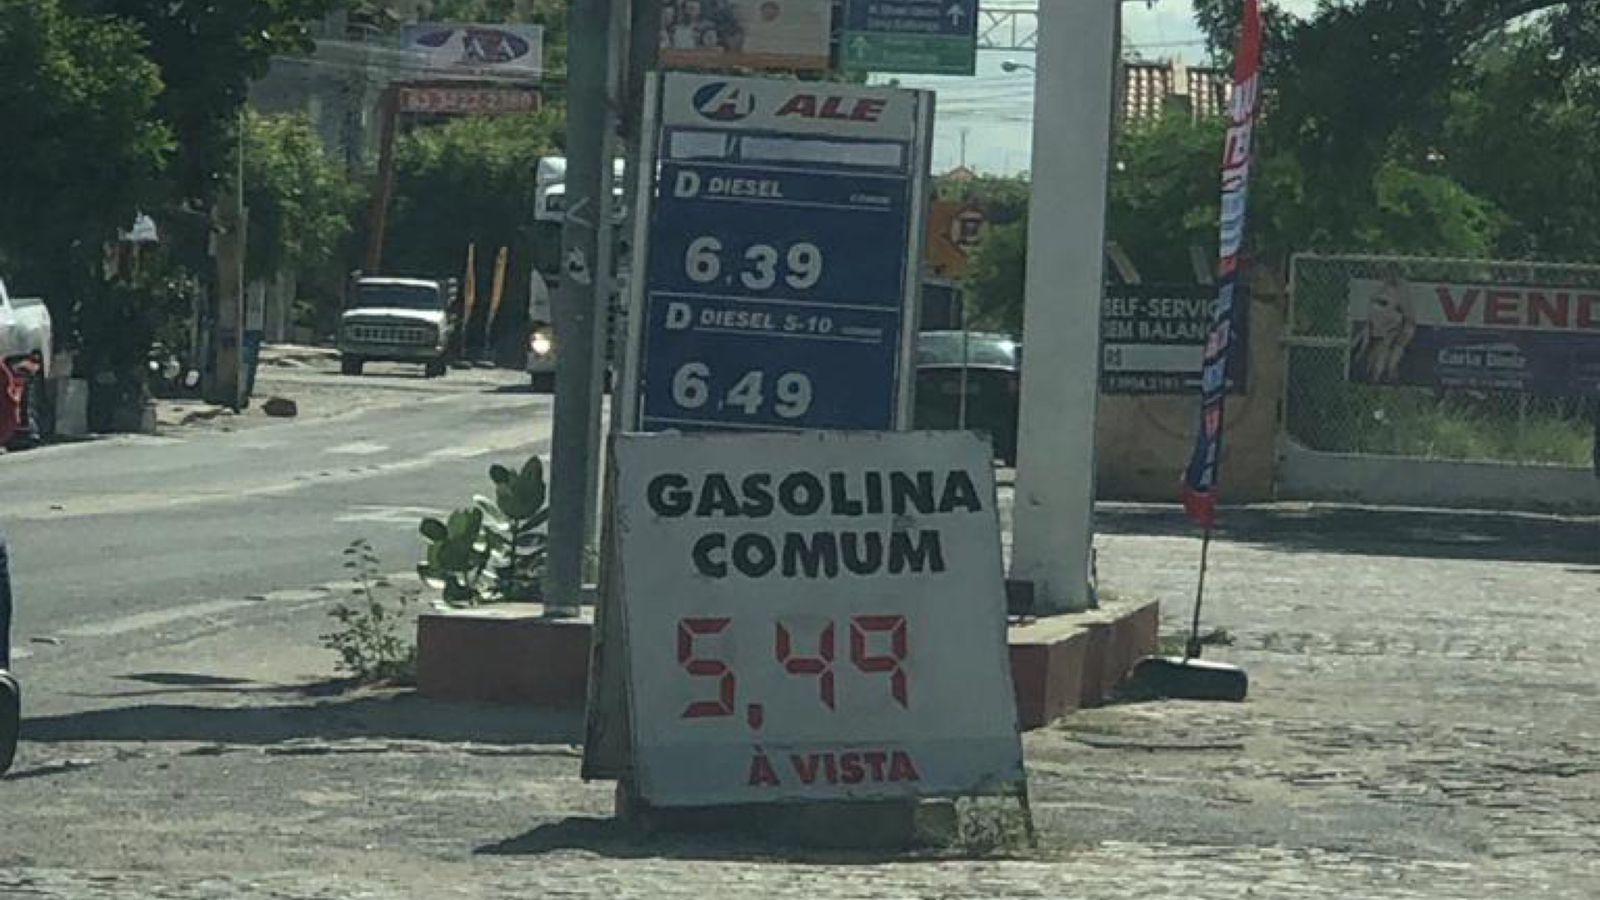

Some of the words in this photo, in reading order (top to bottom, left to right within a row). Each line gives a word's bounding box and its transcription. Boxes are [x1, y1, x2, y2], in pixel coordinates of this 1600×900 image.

[776, 93, 887, 122] ALE
[674, 170, 701, 199] D
[708, 177, 784, 198] DIESEL
[665, 302, 693, 330] D
[699, 309, 776, 329] DIESEL
[783, 315, 833, 333] S-10
[647, 471, 982, 518] GASOLINA
[692, 530, 946, 578] COMUM
[678, 615, 909, 730] 5,49
[748, 746, 780, 787] À
[790, 751, 920, 784] VISTA
